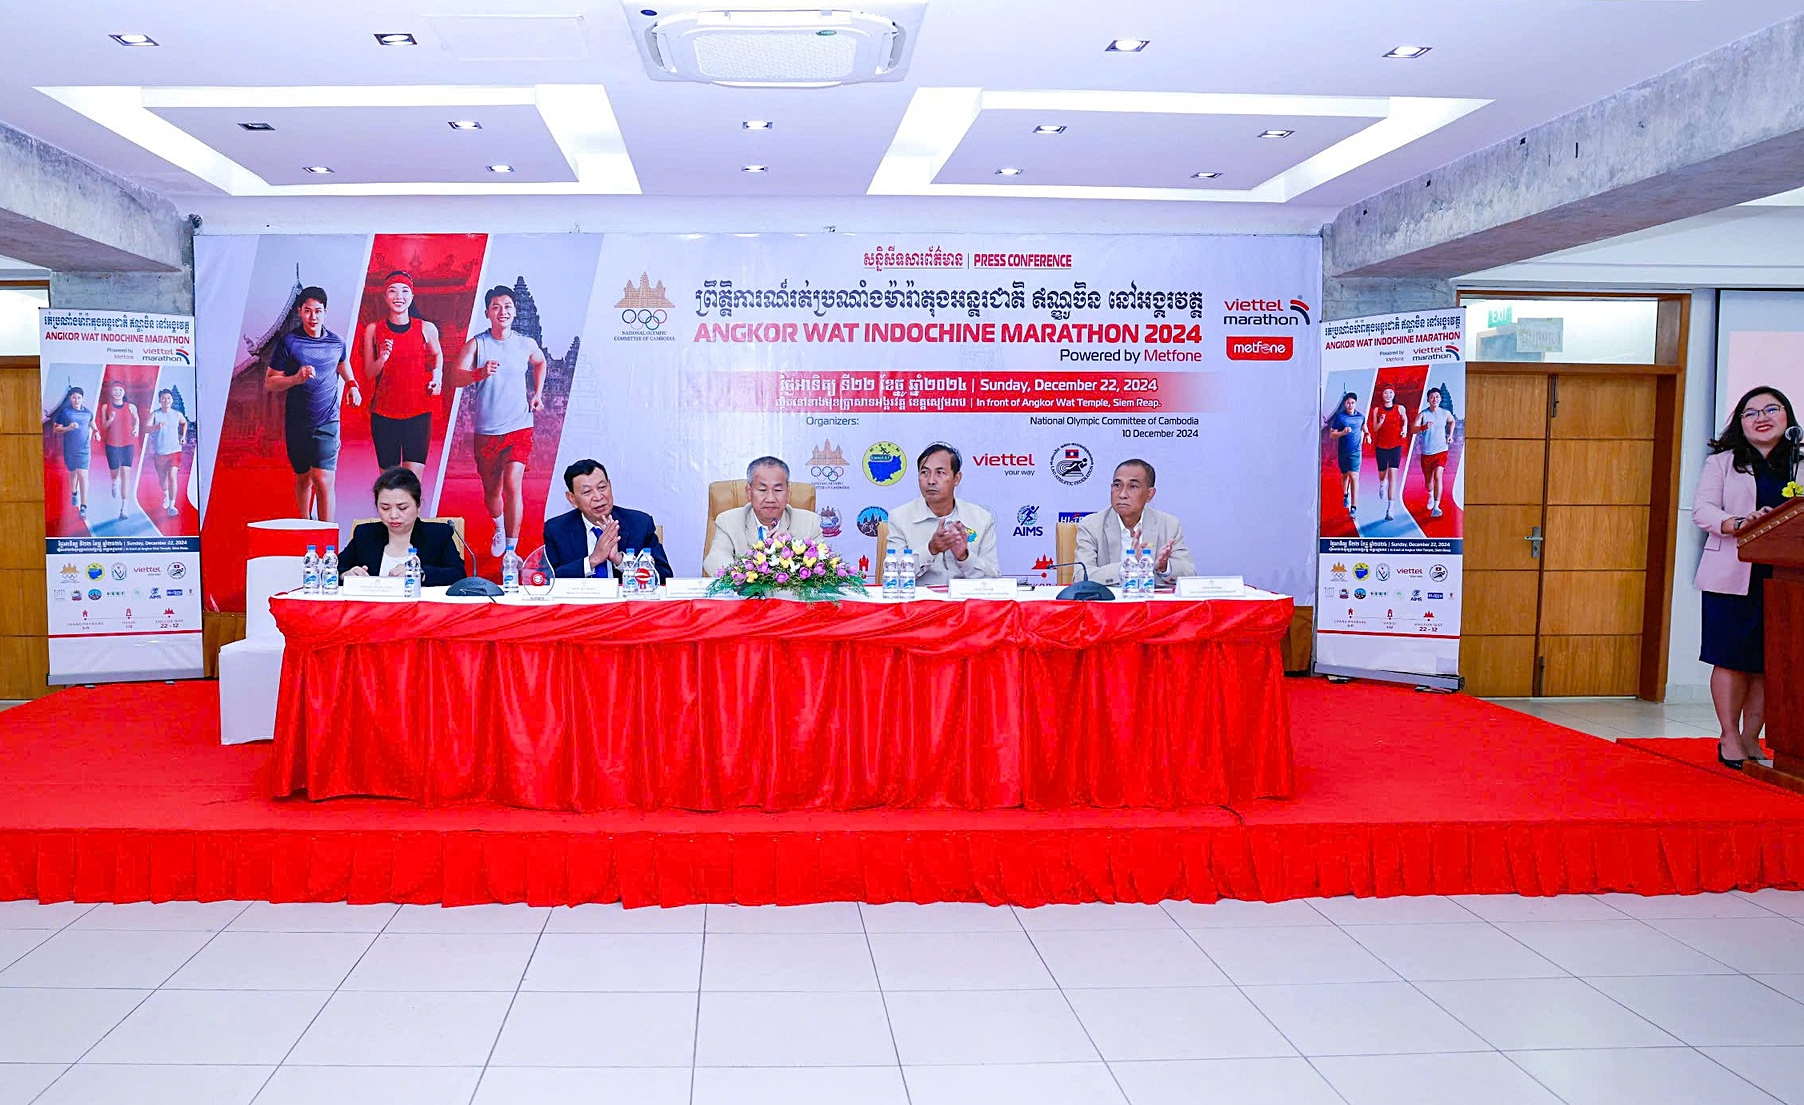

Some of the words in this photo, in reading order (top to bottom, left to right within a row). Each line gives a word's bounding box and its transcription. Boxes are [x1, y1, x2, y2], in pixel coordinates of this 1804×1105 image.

[974, 253, 1006, 267] PRESS
[1007, 253, 1072, 267] CONFERENCE
[1224, 299, 1284, 312] viettel
[1223, 314, 1299, 326] marathon
[45, 331, 80, 341] ANGKOR
[81, 332, 99, 342] WAT
[100, 333, 144, 343] INDOCHINE
[145, 335, 190, 345] MARATHON
[693, 322, 798, 343] ANGKOR
[802, 322, 860, 343] WAT
[864, 322, 996, 343] INDOCHINE
[1000, 323, 1140, 343] MARATHON
[1144, 323, 1203, 344] 2024
[1325, 340, 1355, 350] ANGKOR
[1356, 338, 1373, 348] WAT
[1374, 335, 1414, 346] INDOCHINE
[1415, 331, 1461, 342] MARATHON
[1233, 340, 1286, 355] metfone
[1413, 345, 1443, 355] viettel
[1060, 349, 1121, 362] Powered
[1124, 348, 1140, 364] by
[1144, 349, 1202, 362] Metfone
[1412, 353, 1451, 361] marathon
[980, 378, 1031, 394] Sunday,
[1034, 378, 1098, 391] December
[1100, 379, 1120, 394] 22,
[1123, 379, 1158, 391] 2024
[976, 398, 984, 407] In
[984, 398, 1009, 407] front
[1010, 398, 1021, 407] of
[1021, 398, 1054, 409] Angkor
[1055, 398, 1075, 407] Wat
[1076, 398, 1111, 409] Temple,
[1112, 398, 1134, 407] Siem
[1136, 398, 1162, 409] Reap.
[806, 416, 860, 427] Organizers:
[1030, 416, 1065, 425] National
[1067, 416, 1100, 428] Olympic
[1101, 416, 1146, 425] Committee
[1148, 416, 1157, 425] of
[1158, 416, 1199, 425] Cambodia
[1122, 429, 1131, 438] 10
[1133, 429, 1174, 438] December
[1176, 429, 1199, 438] 2024
[973, 453, 1035, 466] viettel
[1013, 526, 1044, 537] AIMS
